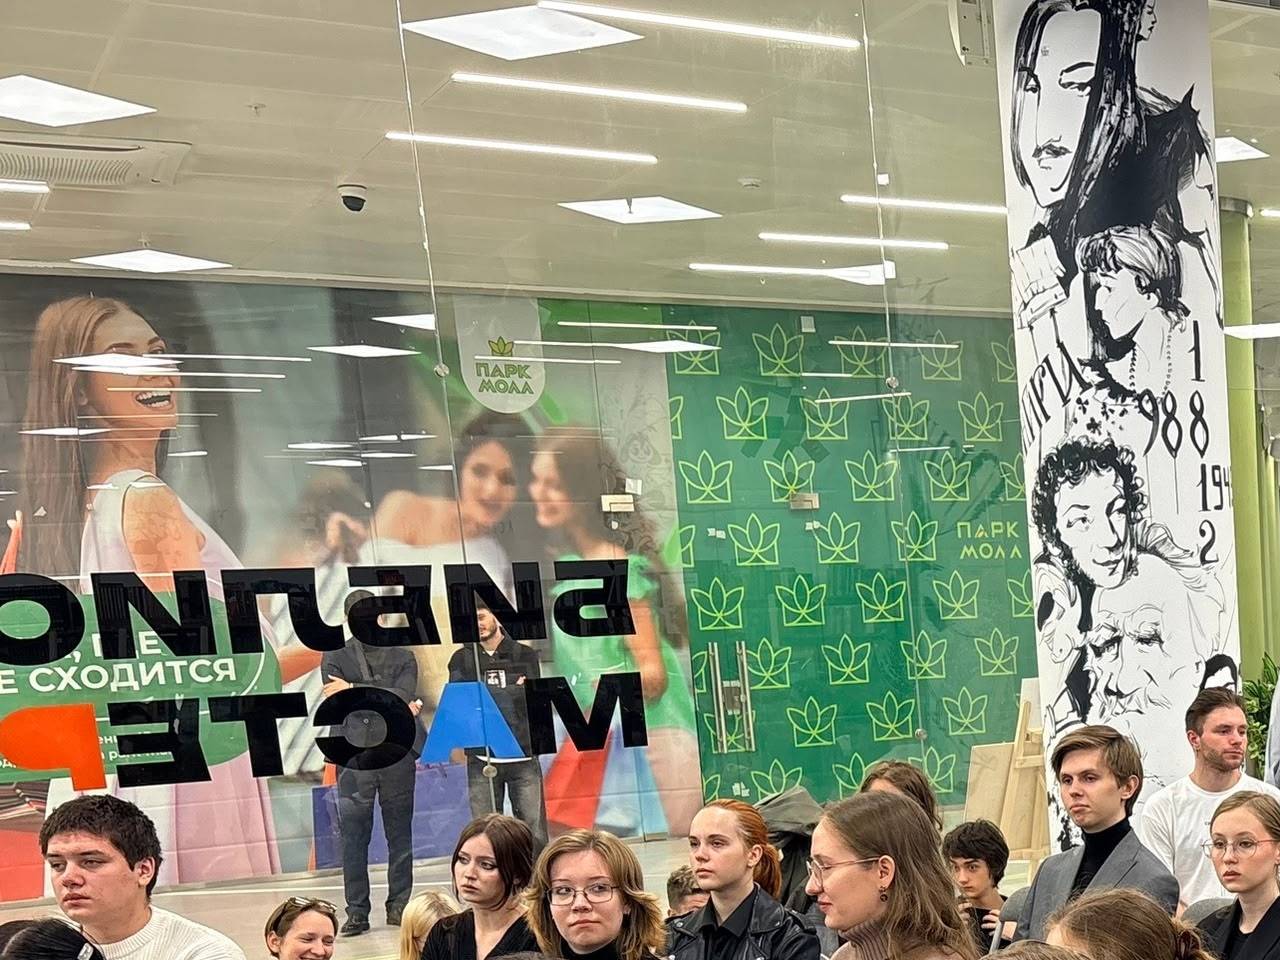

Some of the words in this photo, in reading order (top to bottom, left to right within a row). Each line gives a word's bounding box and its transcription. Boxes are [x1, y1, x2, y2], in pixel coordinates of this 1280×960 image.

[475, 362, 532, 379] ПАРК
[478, 379, 534, 394] МОЛЛ
[957, 522, 1019, 538] ПАРК
[960, 543, 1022, 559] МОЛЛ
[28, 658, 237, 693] СХОДИТСЯ
